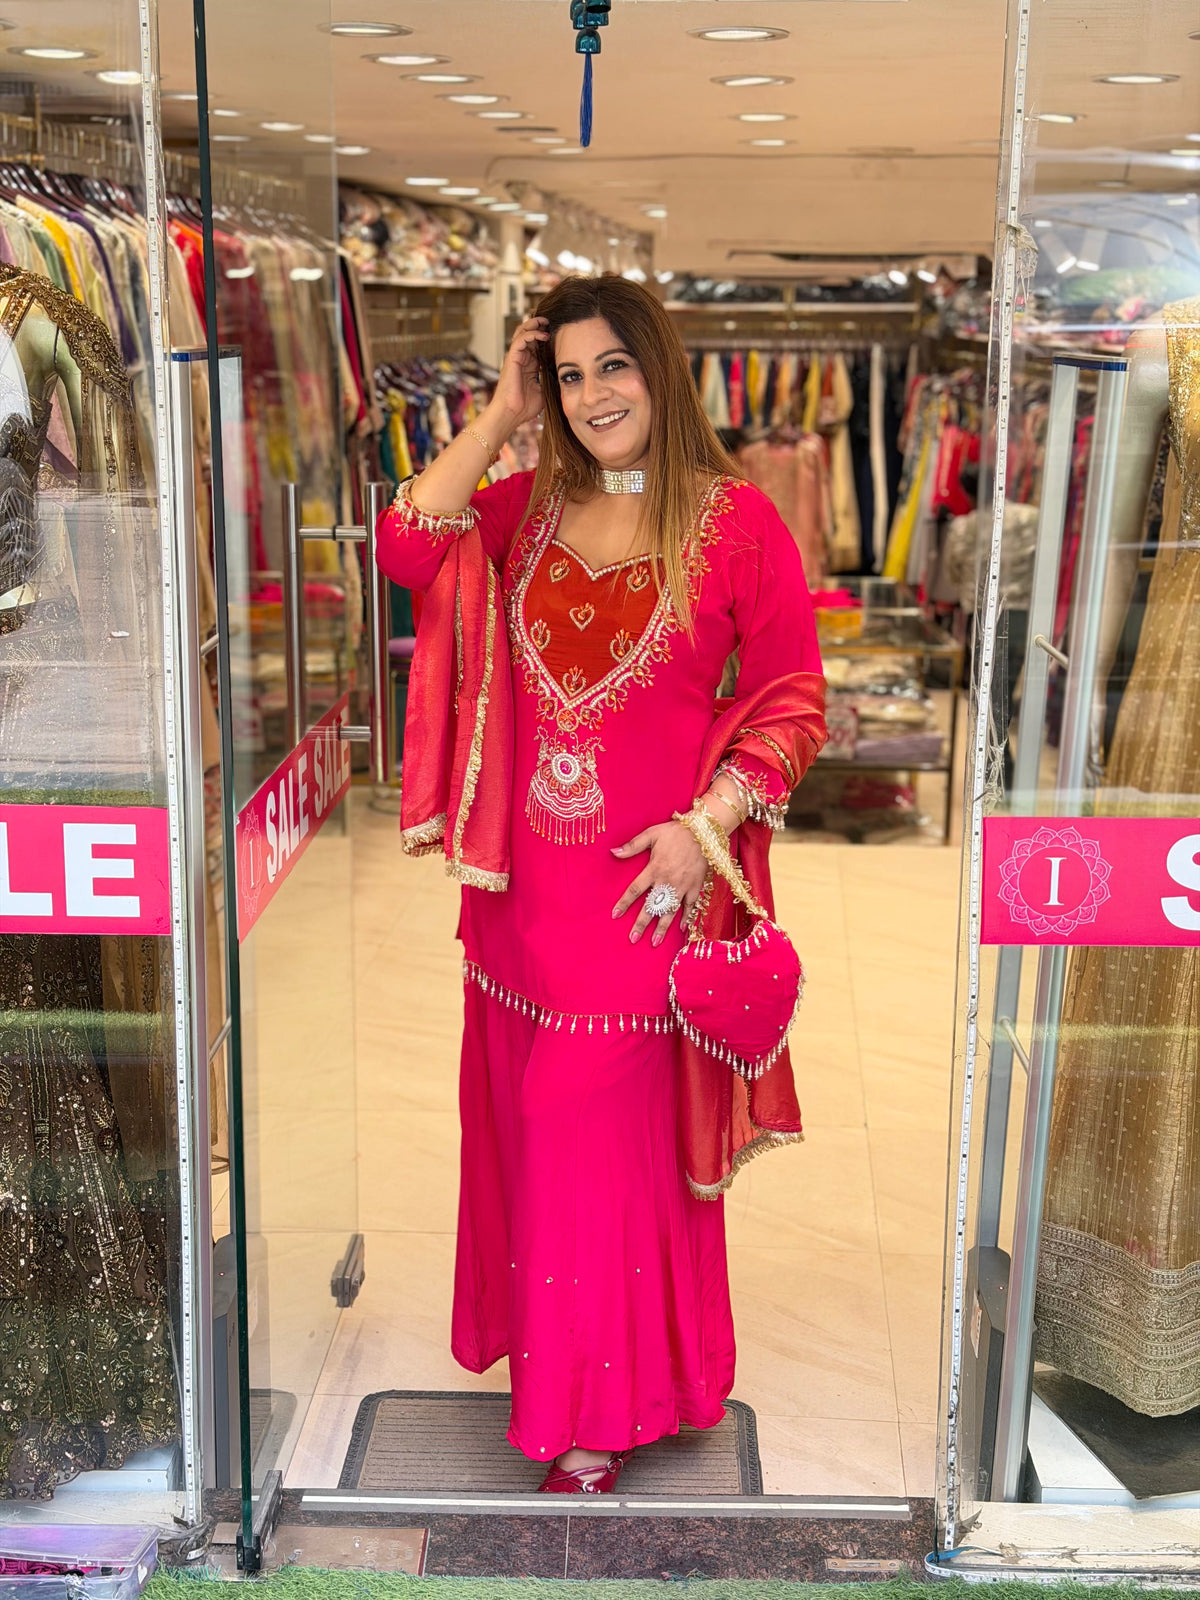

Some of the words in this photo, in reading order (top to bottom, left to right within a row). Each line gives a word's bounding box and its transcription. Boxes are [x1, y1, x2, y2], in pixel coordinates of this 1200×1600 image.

[265, 752, 309, 885] SALE
[314, 706, 349, 818] SALE
[1042, 857, 1068, 906] I
